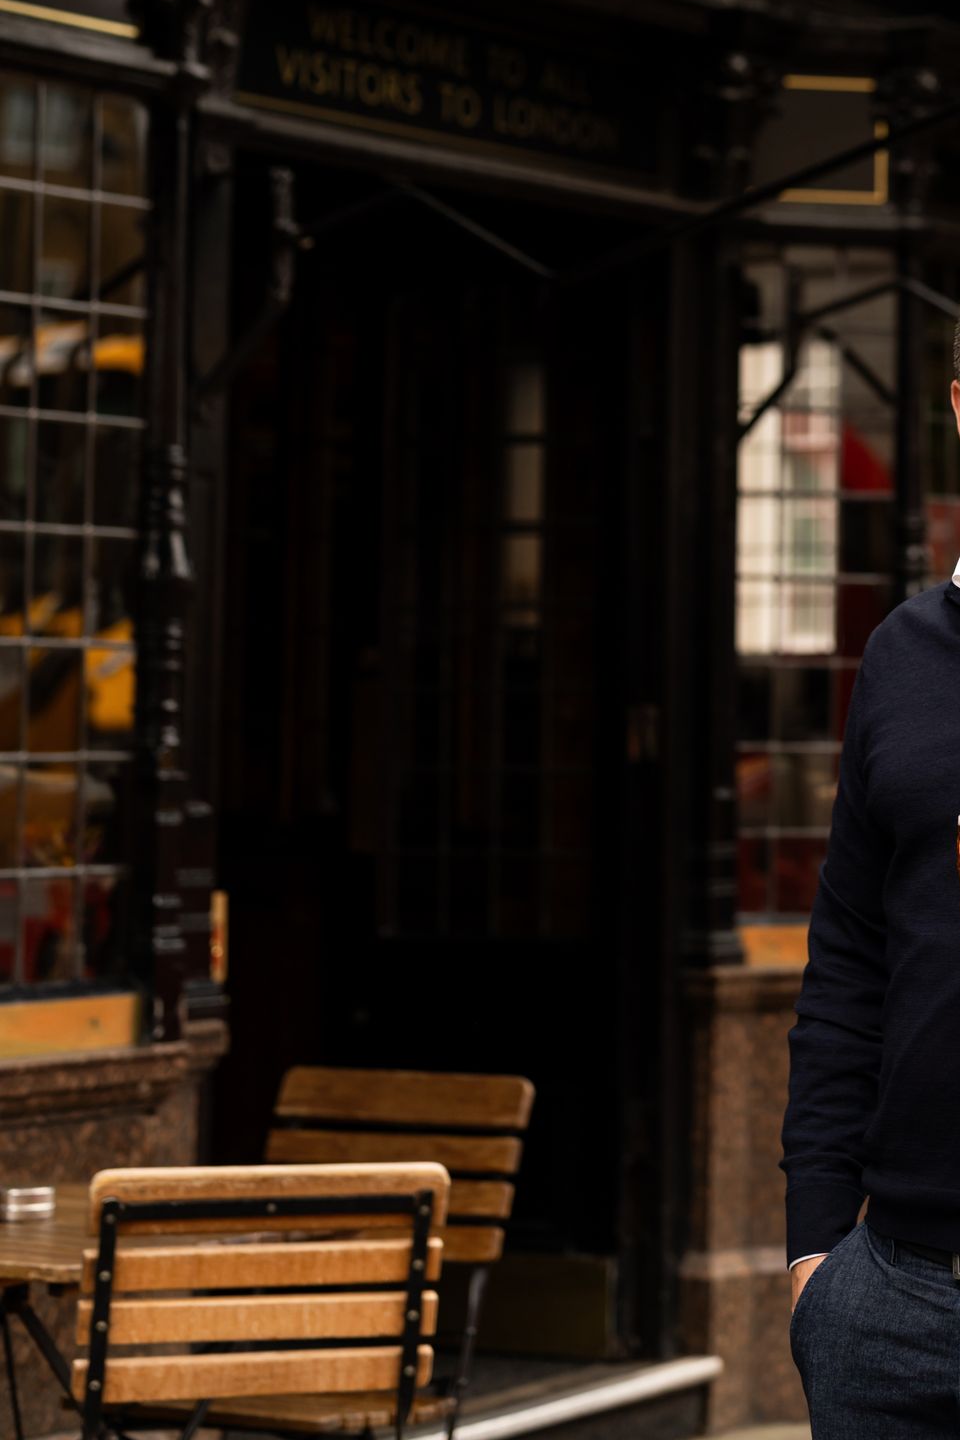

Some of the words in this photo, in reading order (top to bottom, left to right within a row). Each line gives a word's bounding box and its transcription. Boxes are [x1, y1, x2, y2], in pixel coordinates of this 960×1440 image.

[305, 3, 470, 77] WELCOME
[275, 42, 423, 116] VISITORS
[438, 81, 482, 129] TO
